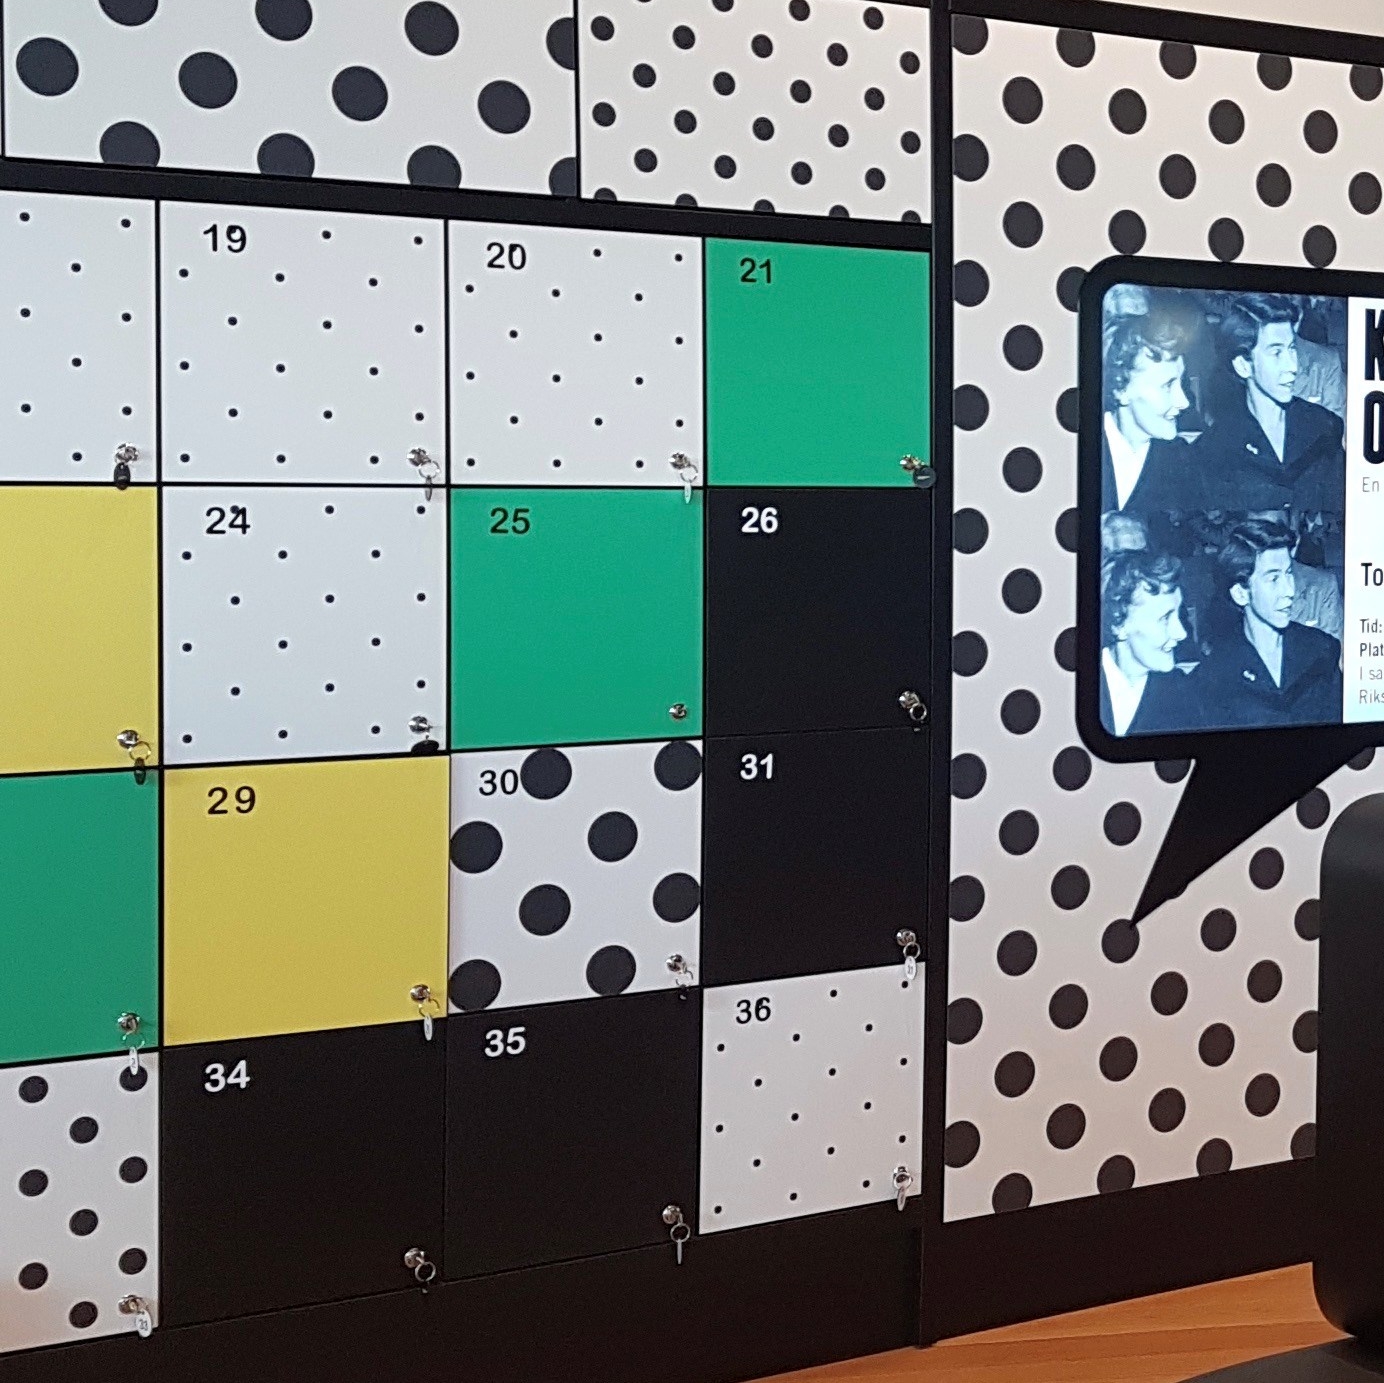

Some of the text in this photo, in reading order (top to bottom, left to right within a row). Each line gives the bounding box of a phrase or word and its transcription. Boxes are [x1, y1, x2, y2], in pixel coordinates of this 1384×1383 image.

[202, 223, 248, 254] 19
[486, 243, 527, 271] 20
[739, 257, 775, 284] 21
[1362, 476, 1381, 494] En
[205, 507, 251, 536] 24
[489, 507, 531, 535] 25
[741, 506, 779, 534] 26
[1360, 617, 1383, 634] Tid:
[740, 752, 775, 780] 31
[478, 768, 519, 796] 30
[206, 785, 257, 815] 29
[735, 996, 772, 1024] 36
[484, 1026, 527, 1058] 35
[203, 1060, 251, 1093] 34
